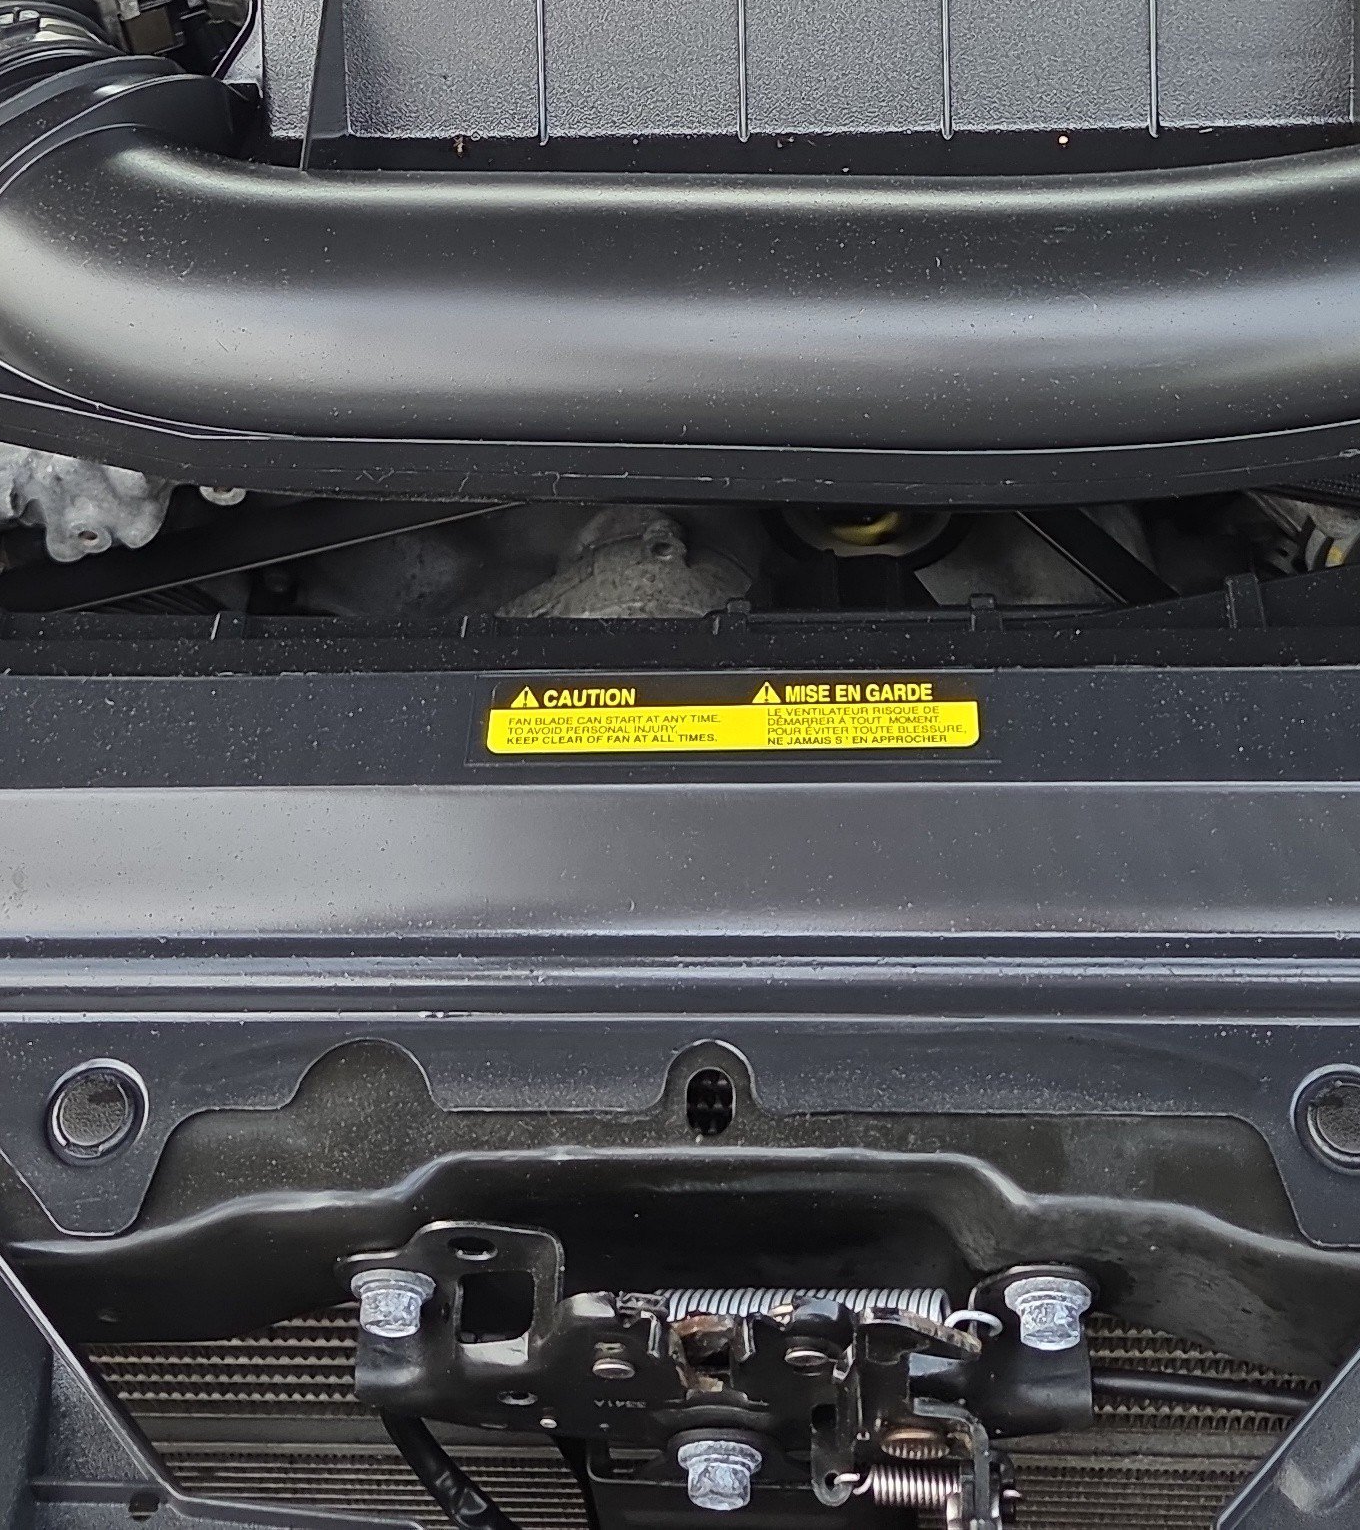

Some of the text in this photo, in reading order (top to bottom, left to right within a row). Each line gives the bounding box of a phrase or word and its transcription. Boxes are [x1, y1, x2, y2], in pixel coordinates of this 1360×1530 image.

[543, 688, 636, 707] CAUTION
[785, 683, 933, 703] MISE EN GARDE
[768, 706, 940, 717] LE VENTILATEUR RISQUE DE
[509, 717, 531, 726] FAN
[535, 716, 573, 726] BLADE
[577, 716, 603, 725] CAN
[605, 715, 644, 724] START
[645, 715, 660, 724] AT
[663, 714, 687, 723] ANY
[850, 716, 882, 725] TOUT
[508, 727, 524, 735] TO
[526, 726, 562, 735] AVOID
[566, 725, 630, 734] PERSONAL
[768, 727, 801, 735] POUR
[853, 726, 893, 734] TOUTE
[507, 736, 539, 745] KEEP
[542, 735, 582, 744] CLEAR
[587, 735, 604, 744] OF
[607, 734, 631, 743] FAN
[634, 734, 649, 743] AT
[651, 734, 674, 743] ALL
[768, 737, 784, 745] NE
[787, 736, 831, 745] JAMAIS
[871, 735, 947, 744] APPROCHER
